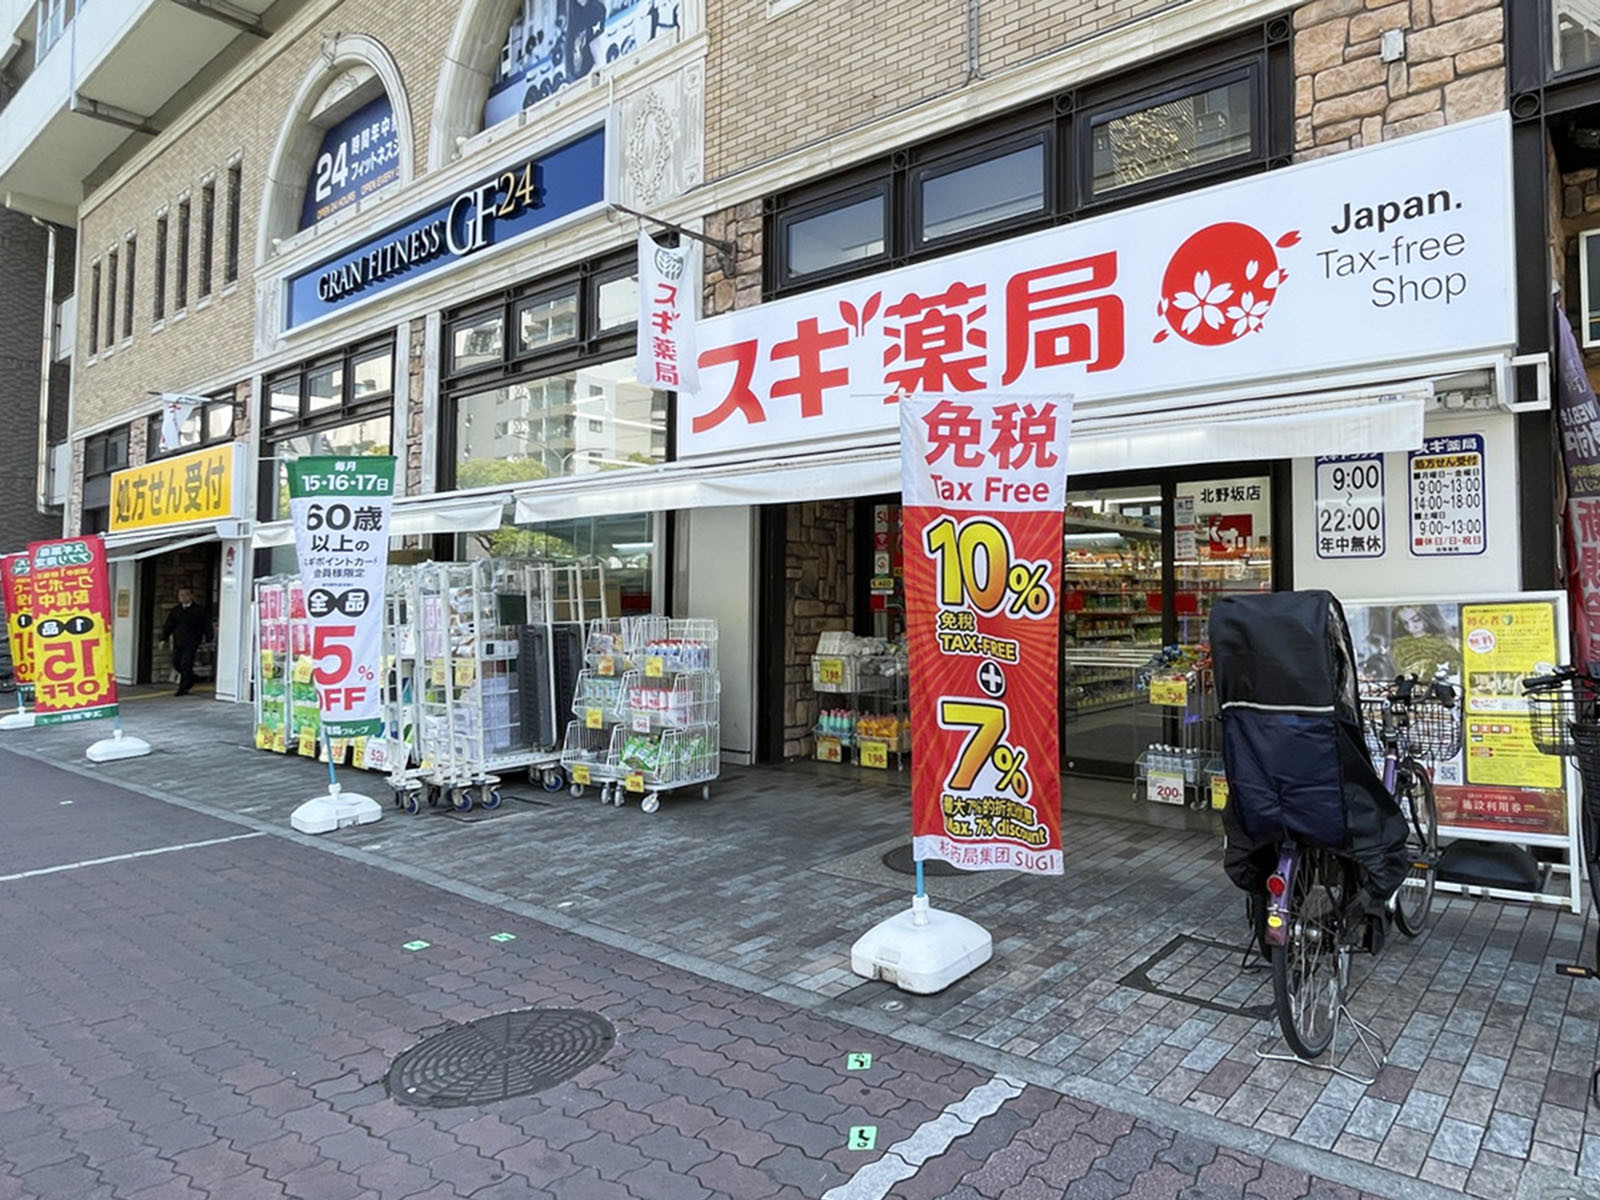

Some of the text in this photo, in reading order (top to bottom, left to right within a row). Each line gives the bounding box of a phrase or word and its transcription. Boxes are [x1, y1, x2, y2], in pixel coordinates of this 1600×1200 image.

[315, 141, 348, 202] 24
[1331, 189, 1462, 235] Japan.
[316, 257, 362, 300] GRAN
[367, 220, 441, 280] FITNESS
[1316, 232, 1465, 279] Tax-free
[1371, 272, 1466, 308] Shop
[652, 283, 681, 386] スギ薬局
[692, 251, 1125, 434] スギ薬局
[921, 399, 1059, 471] 免税
[1414, 437, 1478, 454] スギ薬局
[335, 461, 357, 472] 毎月
[1413, 455, 1478, 469] 処方せん受付
[116, 454, 225, 524] 処方せん受付
[930, 473, 1050, 503] Tax Free
[1332, 464, 1380, 491] 9:00
[1200, 485, 1262, 503] 北野坂店
[306, 503, 383, 532] 60歳
[1320, 506, 1381, 532] 22:00
[311, 534, 370, 552] 以上の
[1320, 536, 1382, 553] 年中無休
[926, 518, 1051, 616] 10%
[310, 591, 366, 613] 全品
[938, 632, 1018, 661] TAX-FREE
[940, 700, 1029, 799] 7%
[1156, 785, 1180, 798] 200
[995, 819, 1048, 845] discount
[1014, 851, 1057, 871] SUGI
